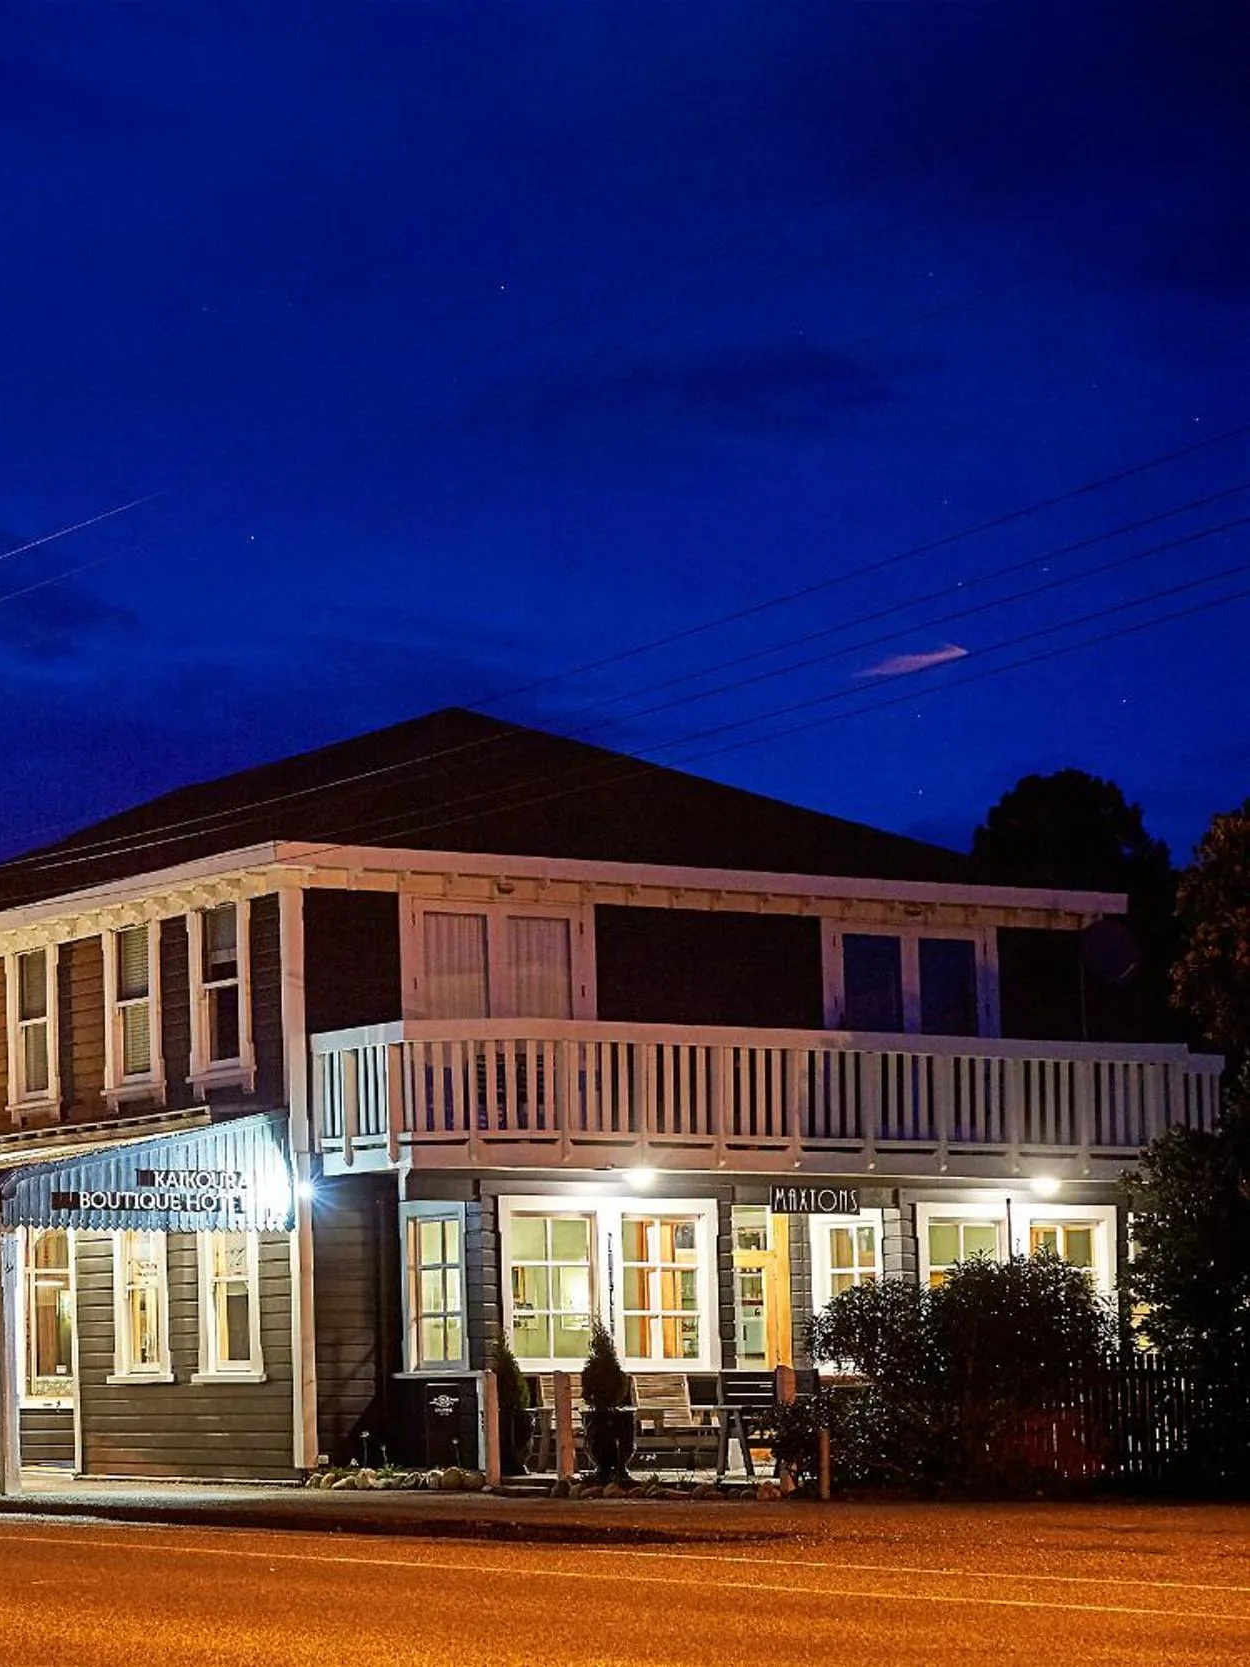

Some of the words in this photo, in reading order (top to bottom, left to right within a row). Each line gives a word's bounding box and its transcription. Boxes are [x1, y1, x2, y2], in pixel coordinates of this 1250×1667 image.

[153, 1171, 247, 1189] KAIKOURA
[79, 1191, 182, 1211] BOUTIQUE
[774, 1187, 859, 1213] MAXTONS
